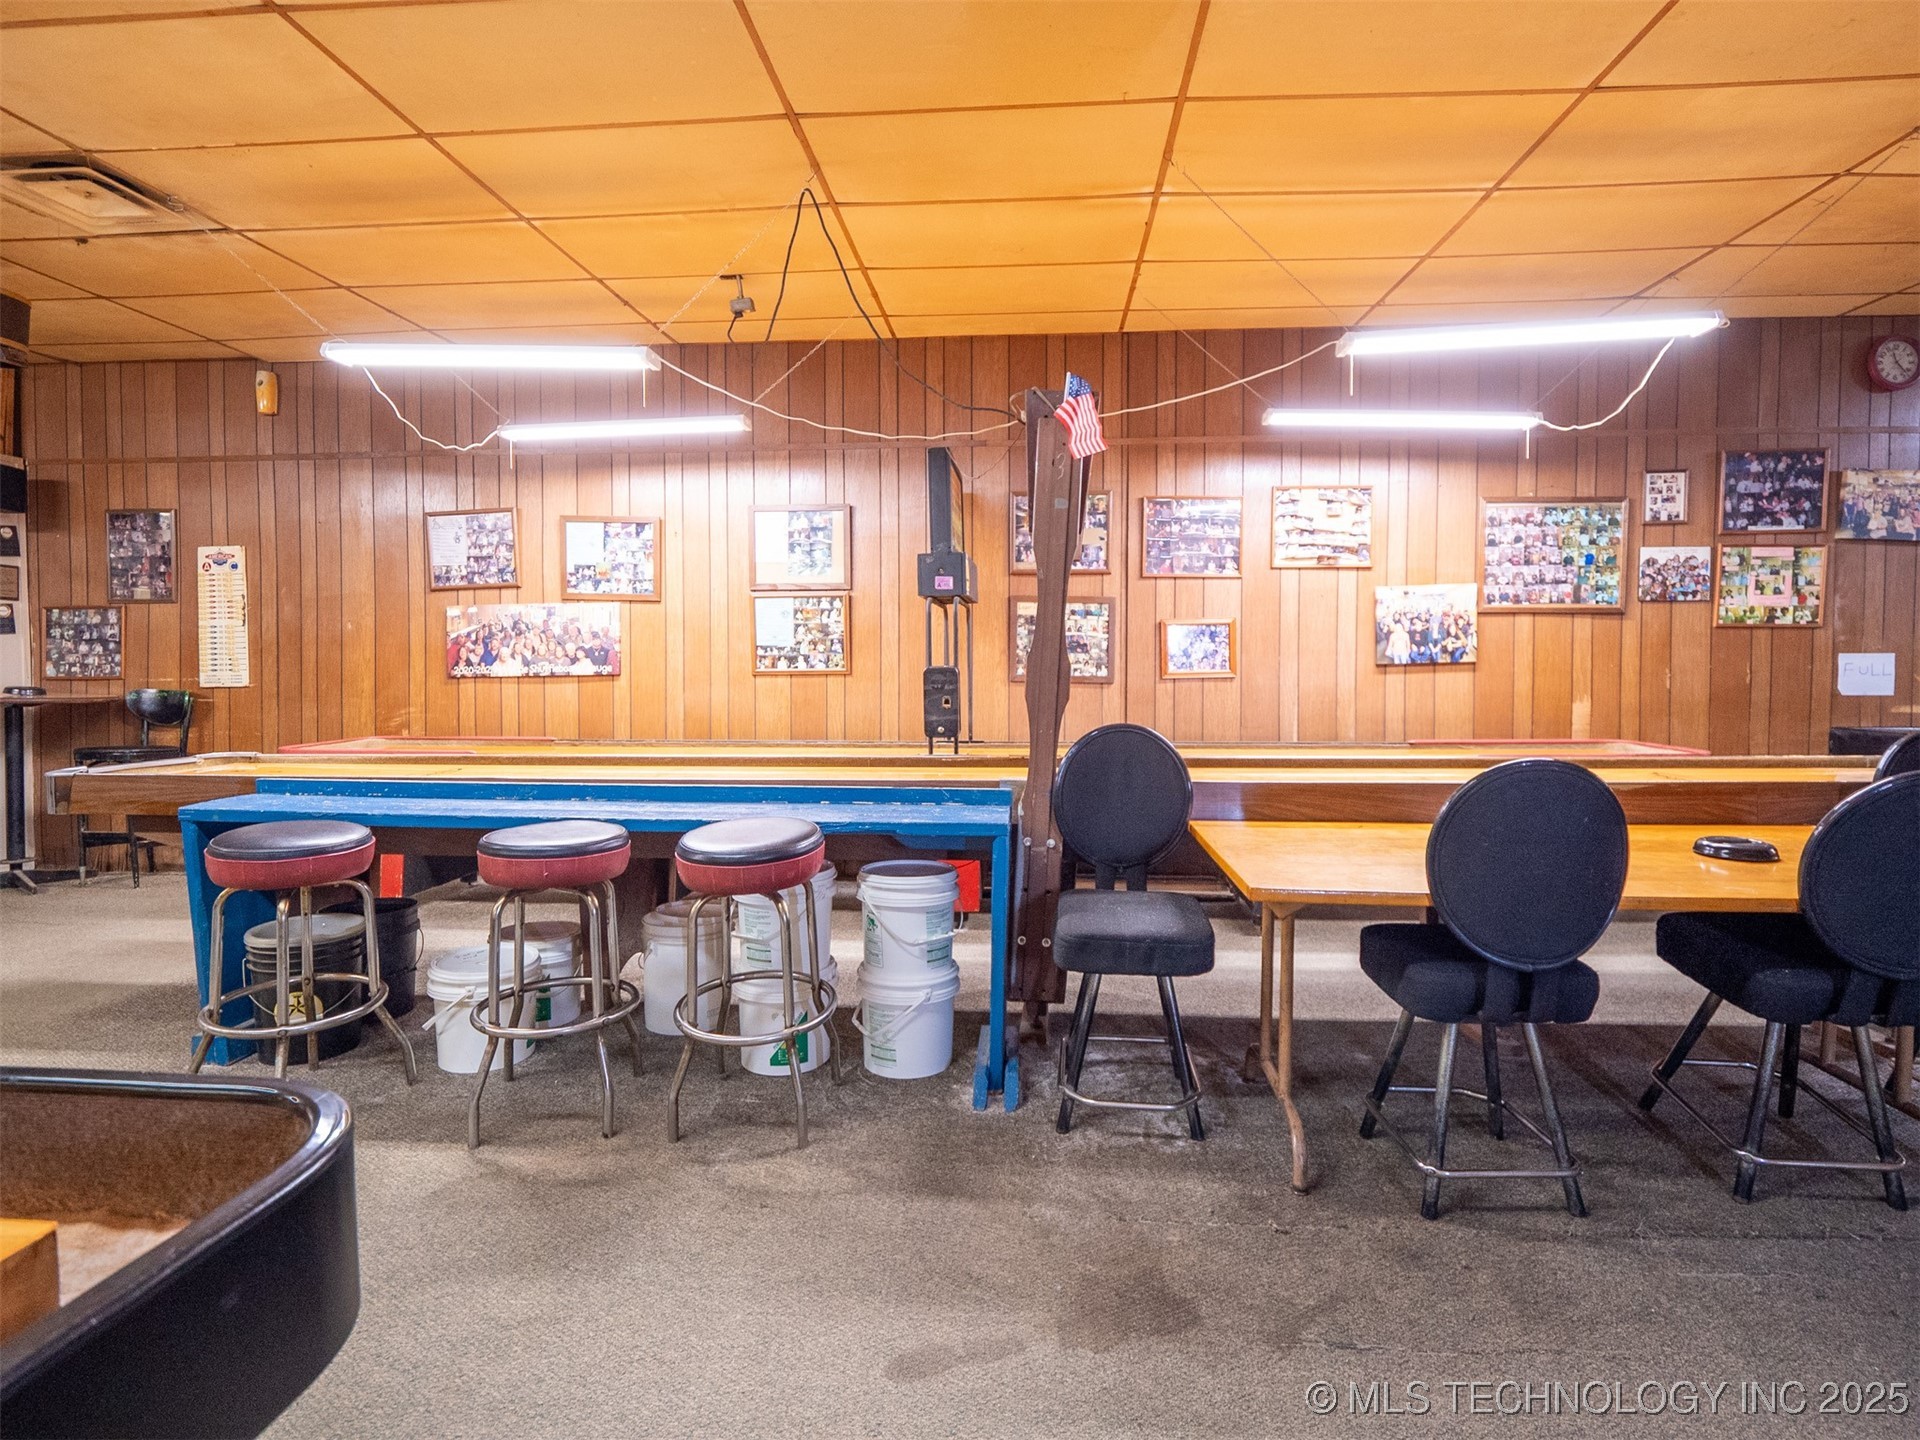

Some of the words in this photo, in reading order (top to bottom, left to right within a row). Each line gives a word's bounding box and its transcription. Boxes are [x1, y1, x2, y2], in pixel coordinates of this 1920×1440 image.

[453, 665, 494, 675] 2020-202
[530, 662, 582, 676] Shuffleboa
[1843, 662, 1892, 677] FULL
